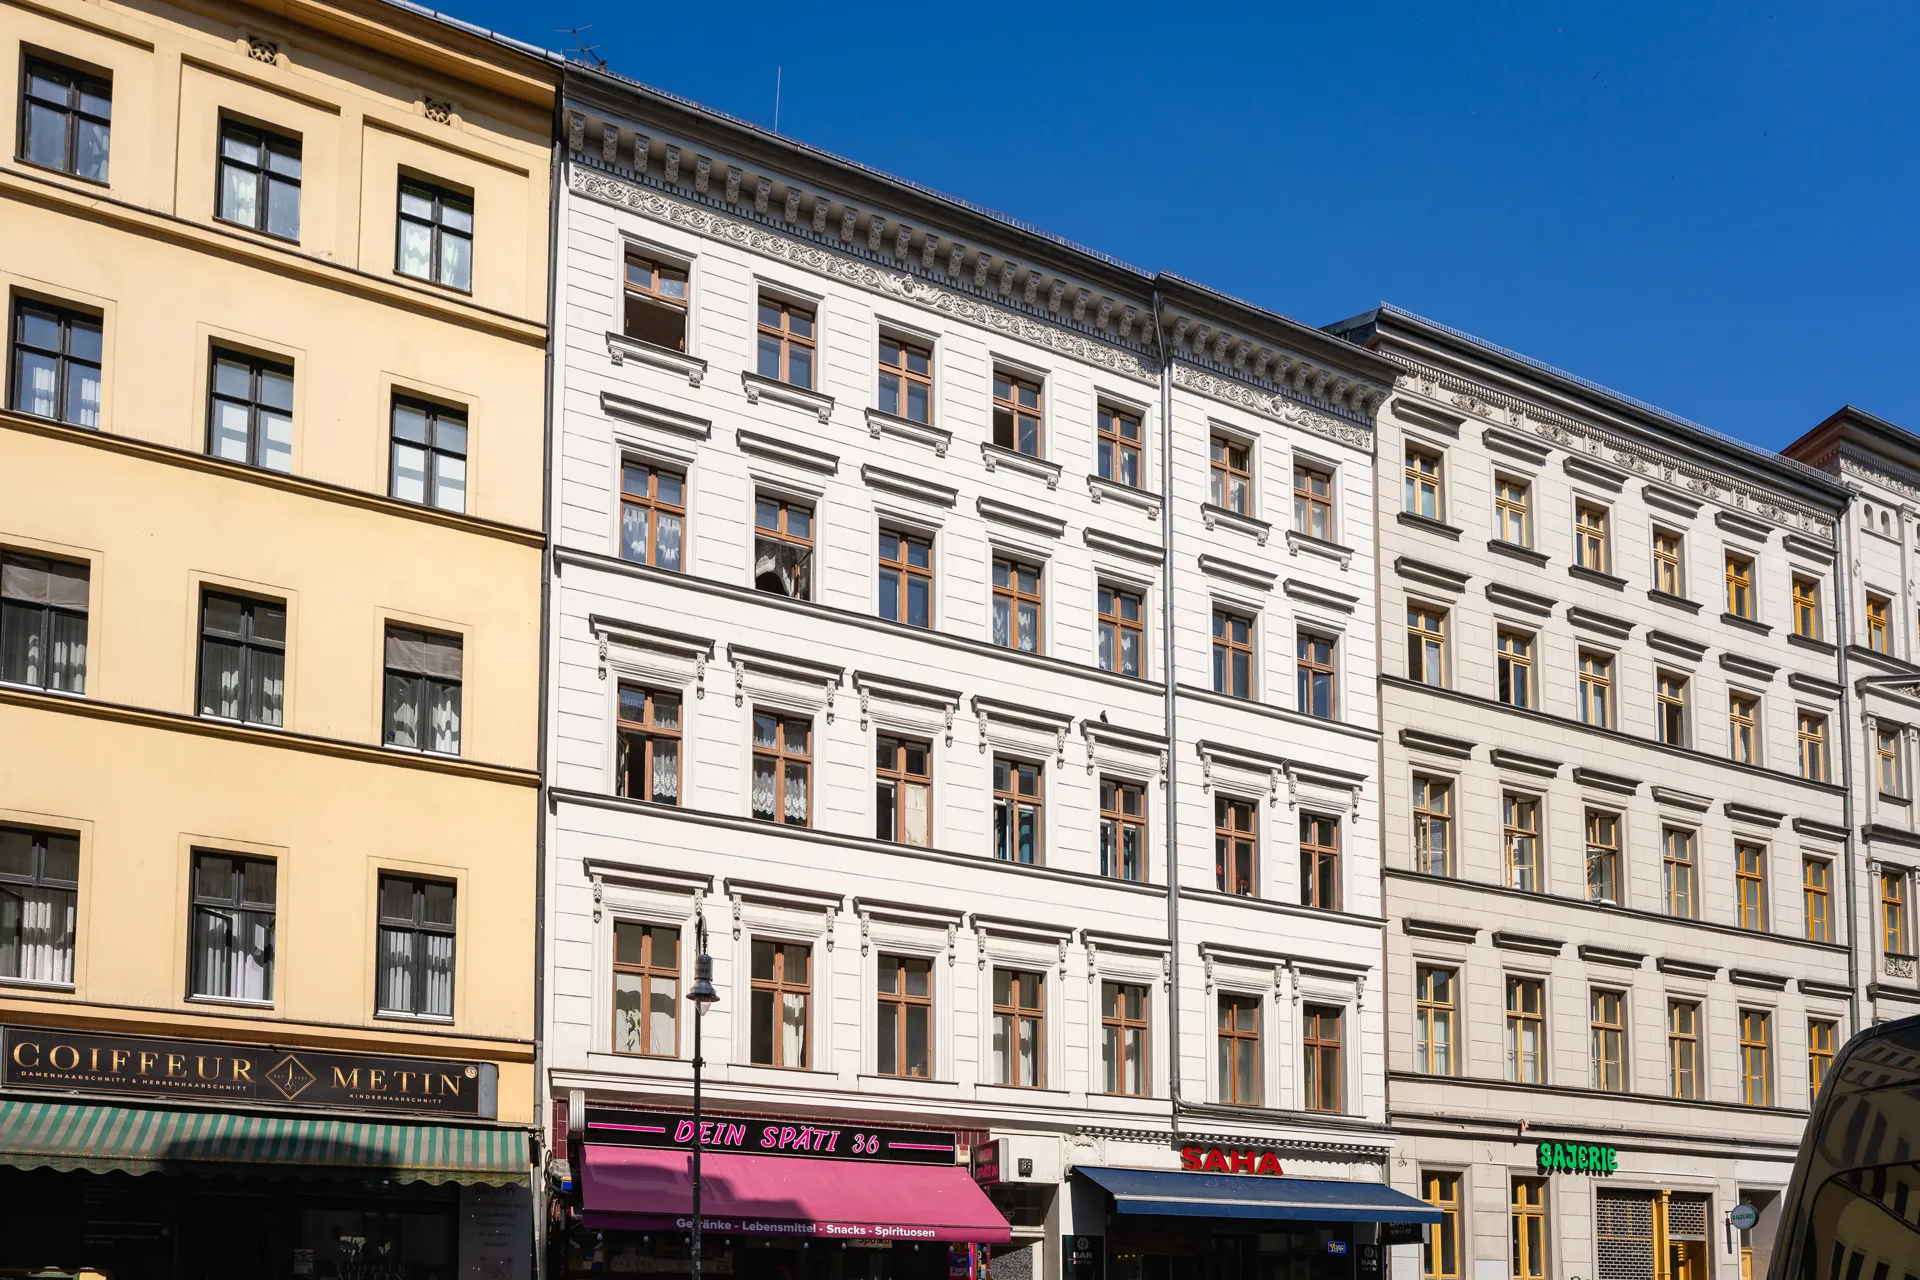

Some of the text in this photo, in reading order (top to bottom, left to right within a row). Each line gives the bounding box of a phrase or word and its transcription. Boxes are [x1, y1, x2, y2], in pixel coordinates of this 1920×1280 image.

[13, 1042, 256, 1083] COIFFEUR
[21, 1070, 126, 1083] DAMENHAARSCHNITT
[142, 1079, 247, 1091] HERRENHAARSCHNITT
[331, 1066, 462, 1096] METIN
[350, 1093, 442, 1104] KINDERHAARSCHNITT
[674, 1119, 880, 1154] DEIN SPÄTI 36
[1180, 1146, 1284, 1175] SAHA
[1540, 1142, 1619, 1172] SAJERIE
[676, 1218, 732, 1230] Geränke
[742, 1221, 816, 1233] Lebensmittel
[826, 1224, 866, 1235] Snacks
[875, 1226, 936, 1238] Spirituosen
[1073, 1251, 1092, 1259] BAR
